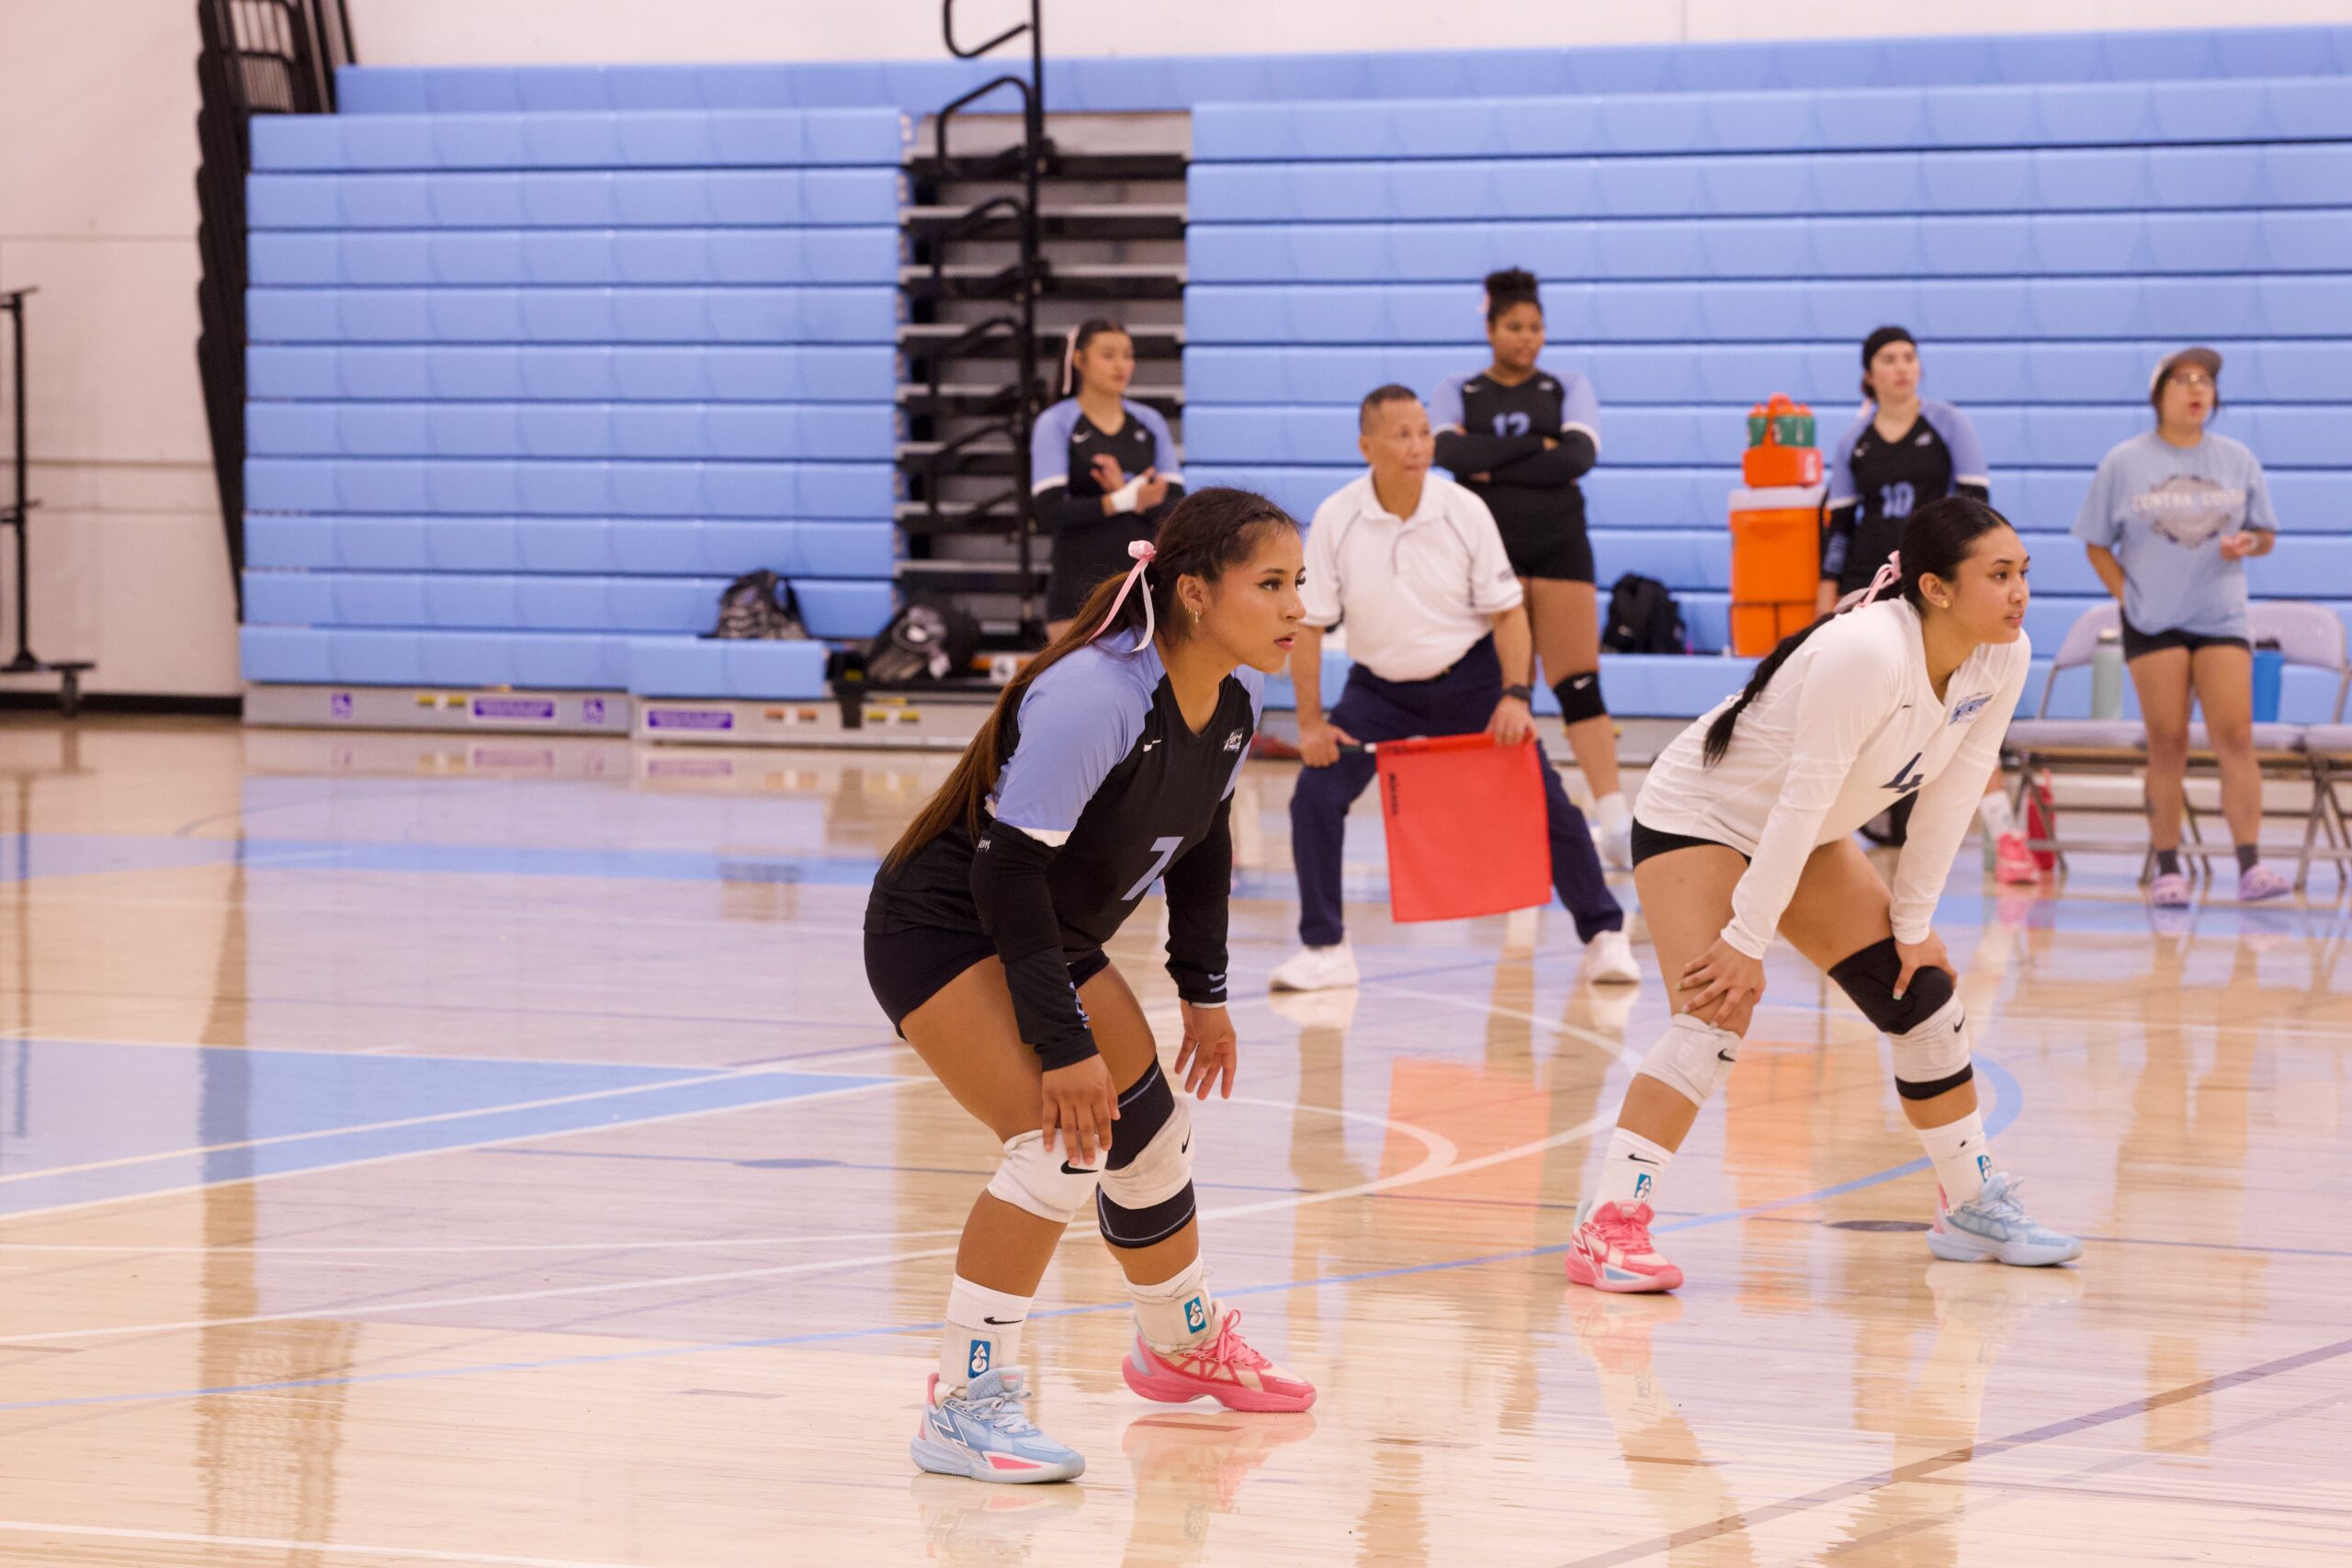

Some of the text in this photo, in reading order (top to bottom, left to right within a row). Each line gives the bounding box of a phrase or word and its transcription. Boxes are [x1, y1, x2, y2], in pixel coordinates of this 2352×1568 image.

[1879, 479, 1916, 520] 10
[1879, 751, 1925, 794] 4
[1121, 836, 1185, 901] 7
